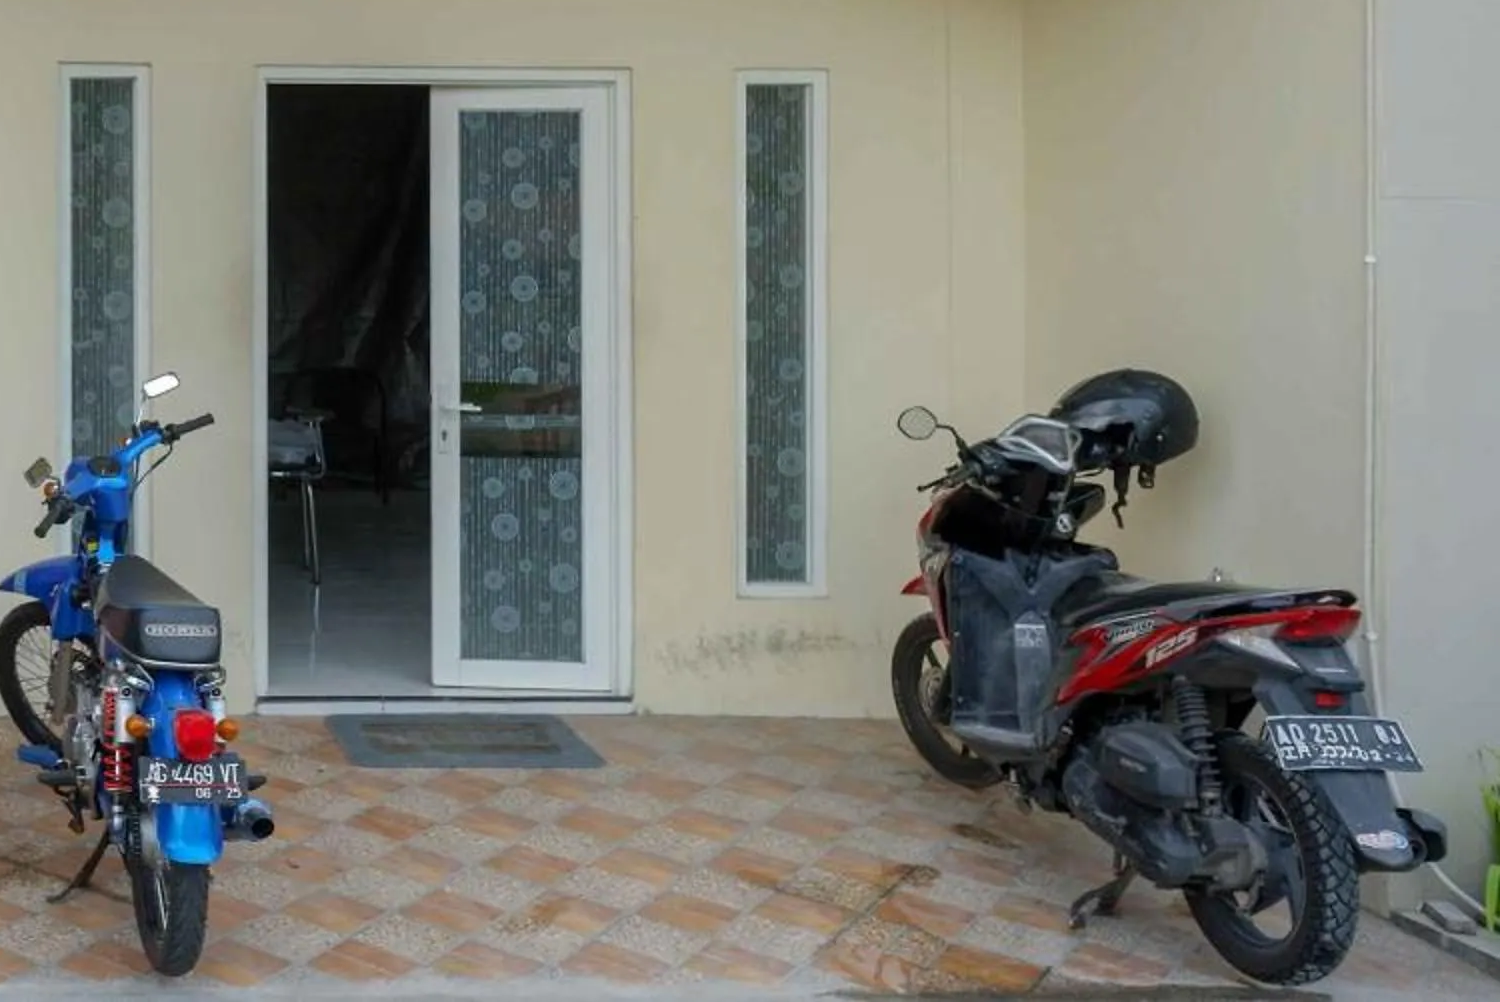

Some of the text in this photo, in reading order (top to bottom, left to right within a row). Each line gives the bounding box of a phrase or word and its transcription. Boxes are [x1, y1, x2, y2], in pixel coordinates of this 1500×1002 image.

[1309, 723, 1359, 743] 2511
[172, 762, 214, 784] 4469
[220, 762, 240, 783] VT
